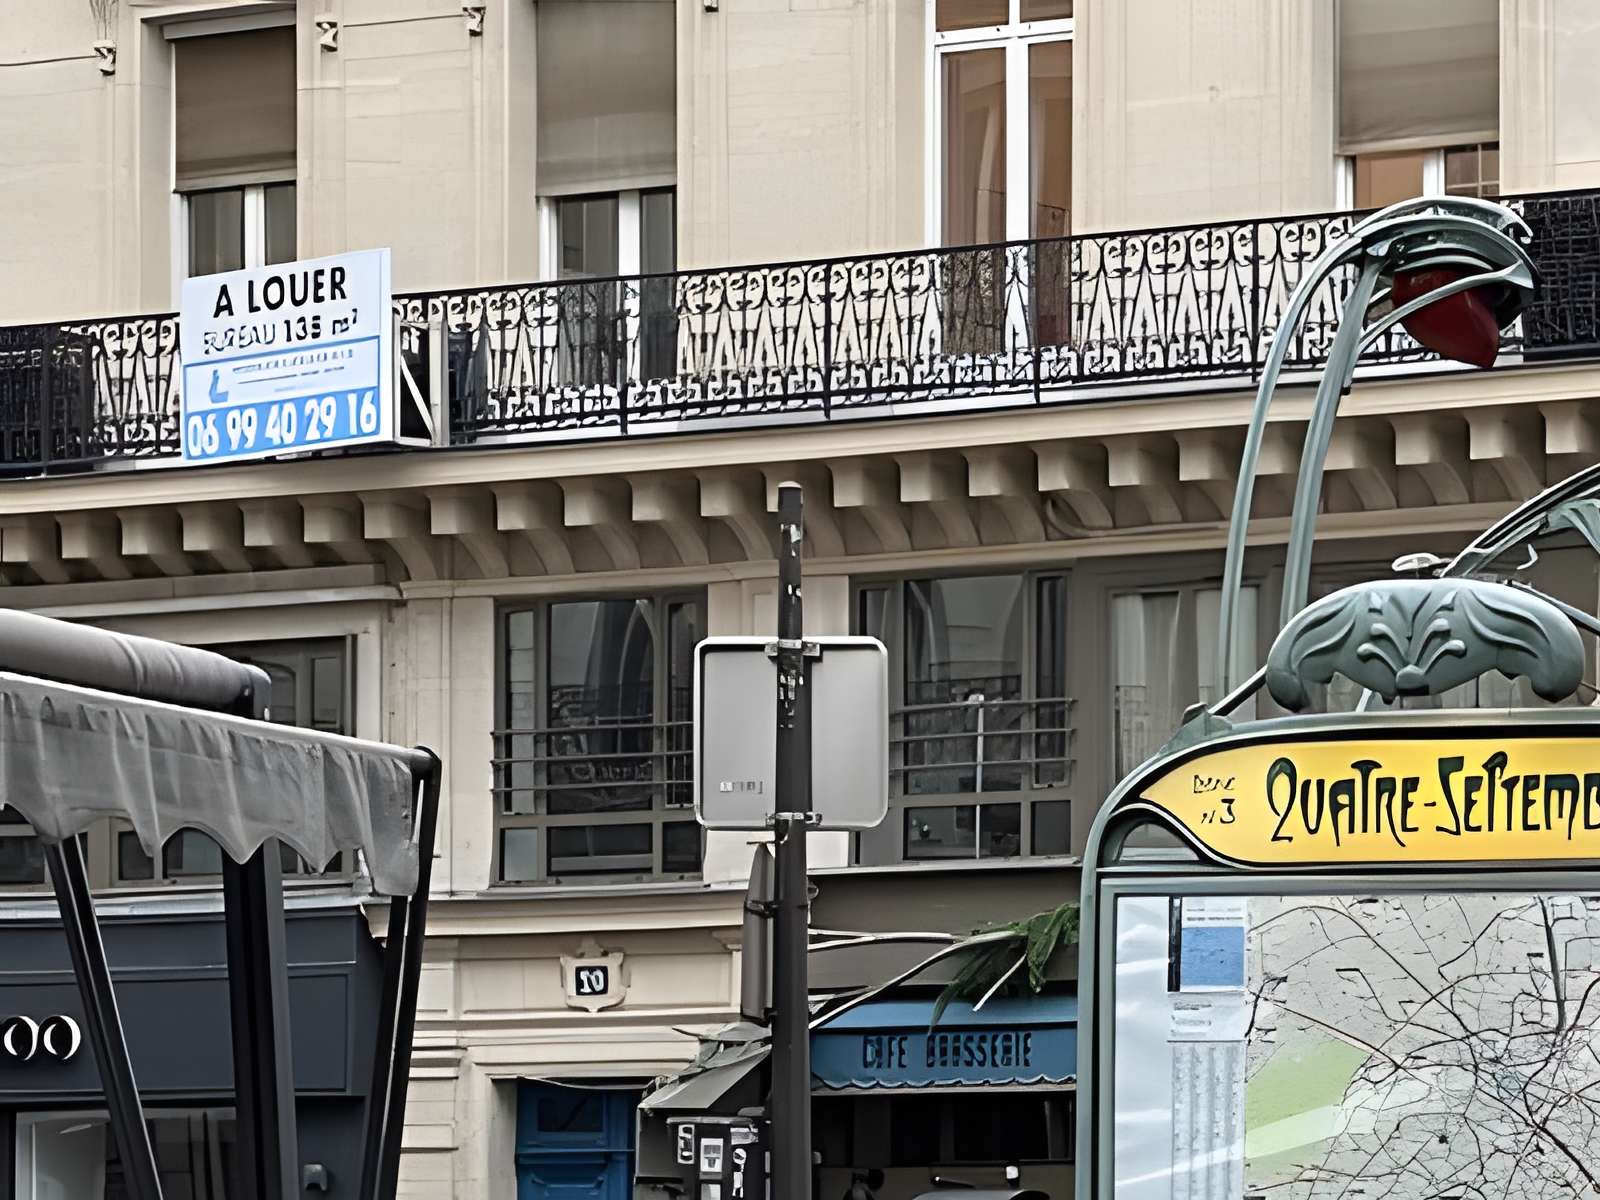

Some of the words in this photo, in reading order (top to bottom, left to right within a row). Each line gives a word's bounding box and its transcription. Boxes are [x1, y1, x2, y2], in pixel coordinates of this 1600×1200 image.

[213, 284, 234, 318] A
[248, 266, 347, 314] LOUER
[187, 412, 220, 455] 06
[226, 407, 258, 450] 99
[264, 401, 297, 445] 40
[303, 396, 337, 440] 29
[346, 390, 378, 435] 16
